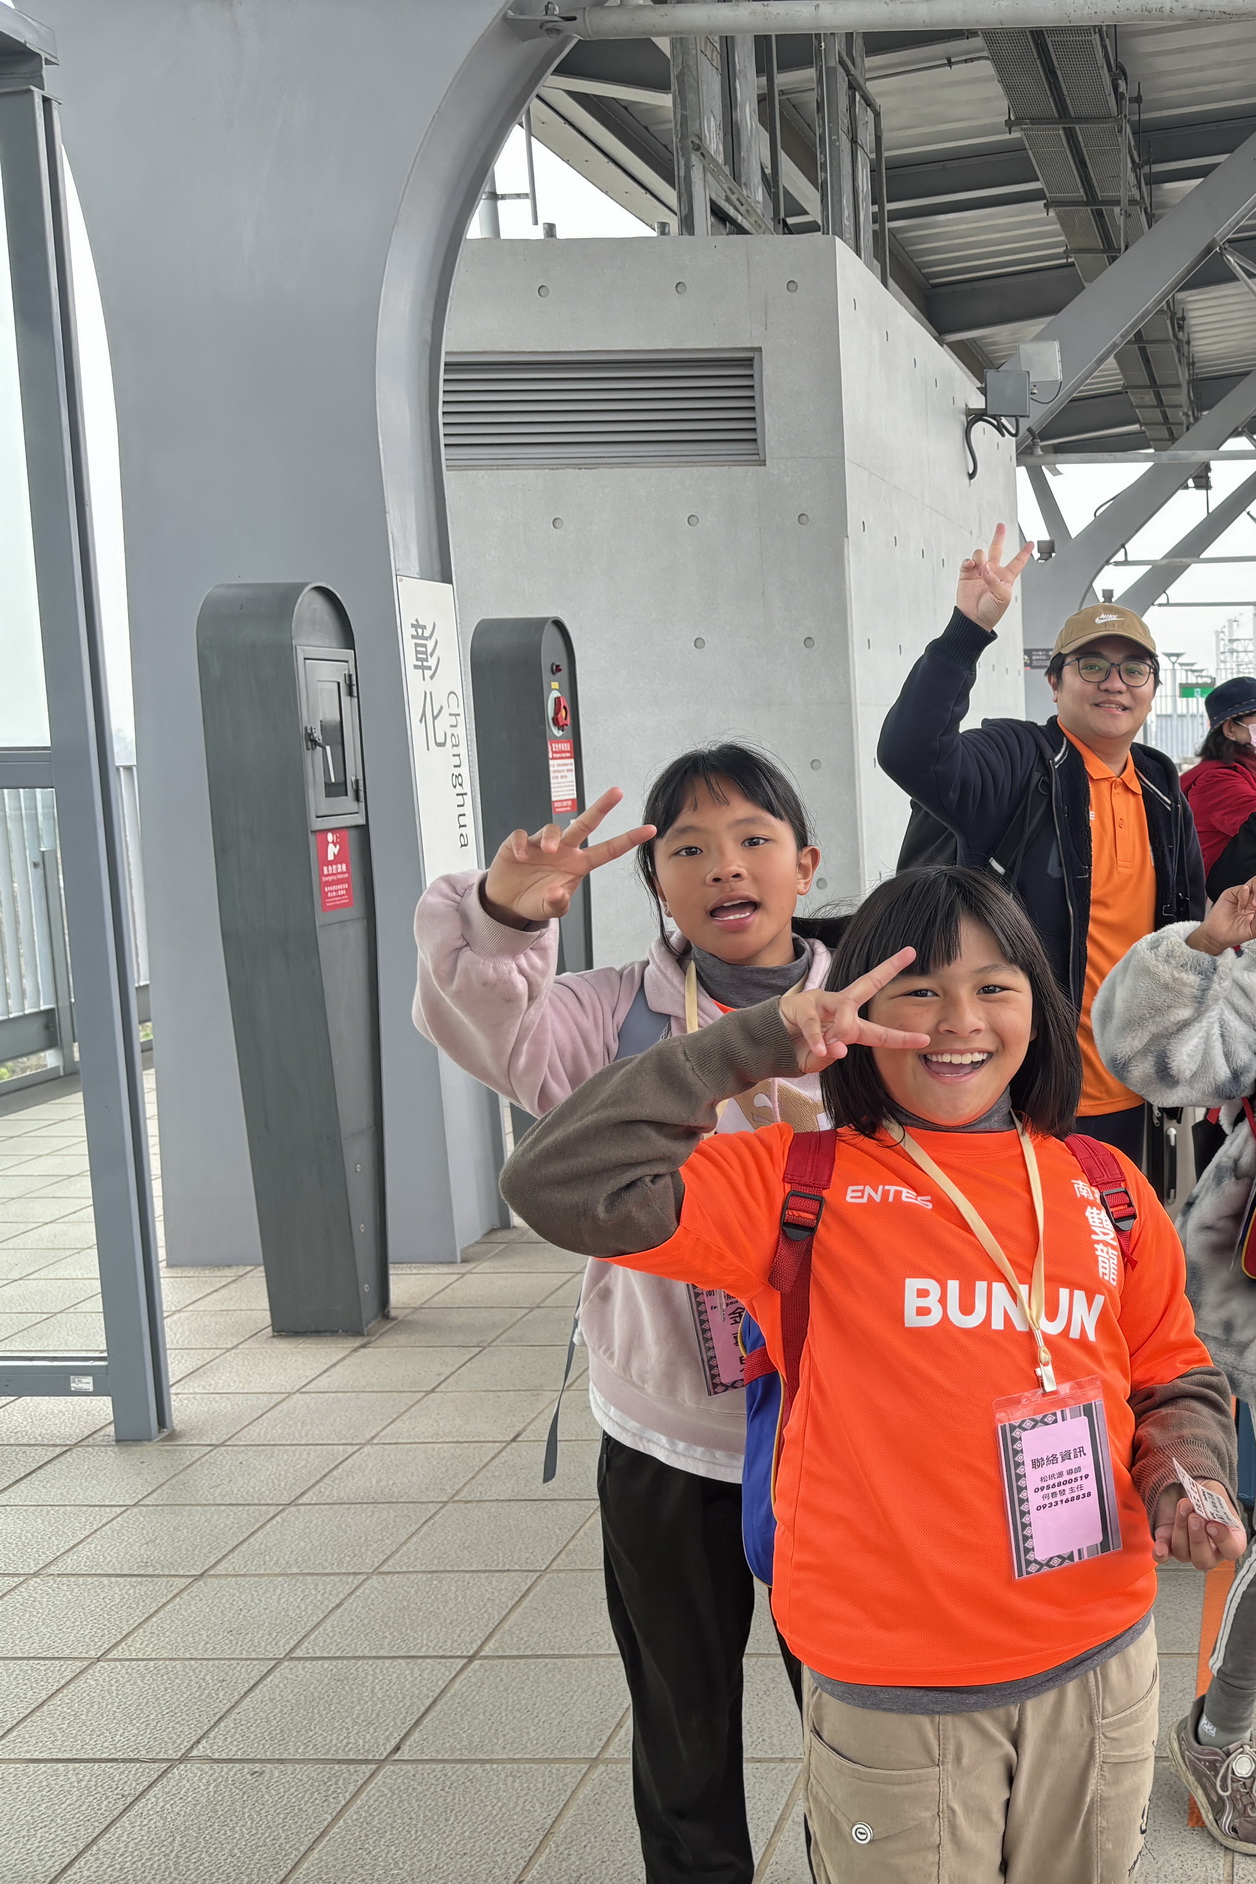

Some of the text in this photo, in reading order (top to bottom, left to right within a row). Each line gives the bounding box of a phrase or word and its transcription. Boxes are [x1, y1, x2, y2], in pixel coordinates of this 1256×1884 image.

[410, 618, 448, 752] 彰化
[446, 690, 469, 849] Changhua
[845, 1184, 933, 1209] ENTES
[1085, 1205, 1118, 1287] 雙龍
[904, 1278, 1105, 1342] BUNUN
[1031, 1446, 1086, 1470] 聯絡資訊
[1033, 1473, 1090, 1493] 0956800519
[1068, 1484, 1084, 1494] 主任
[1035, 1491, 1092, 1511] 0933168838
